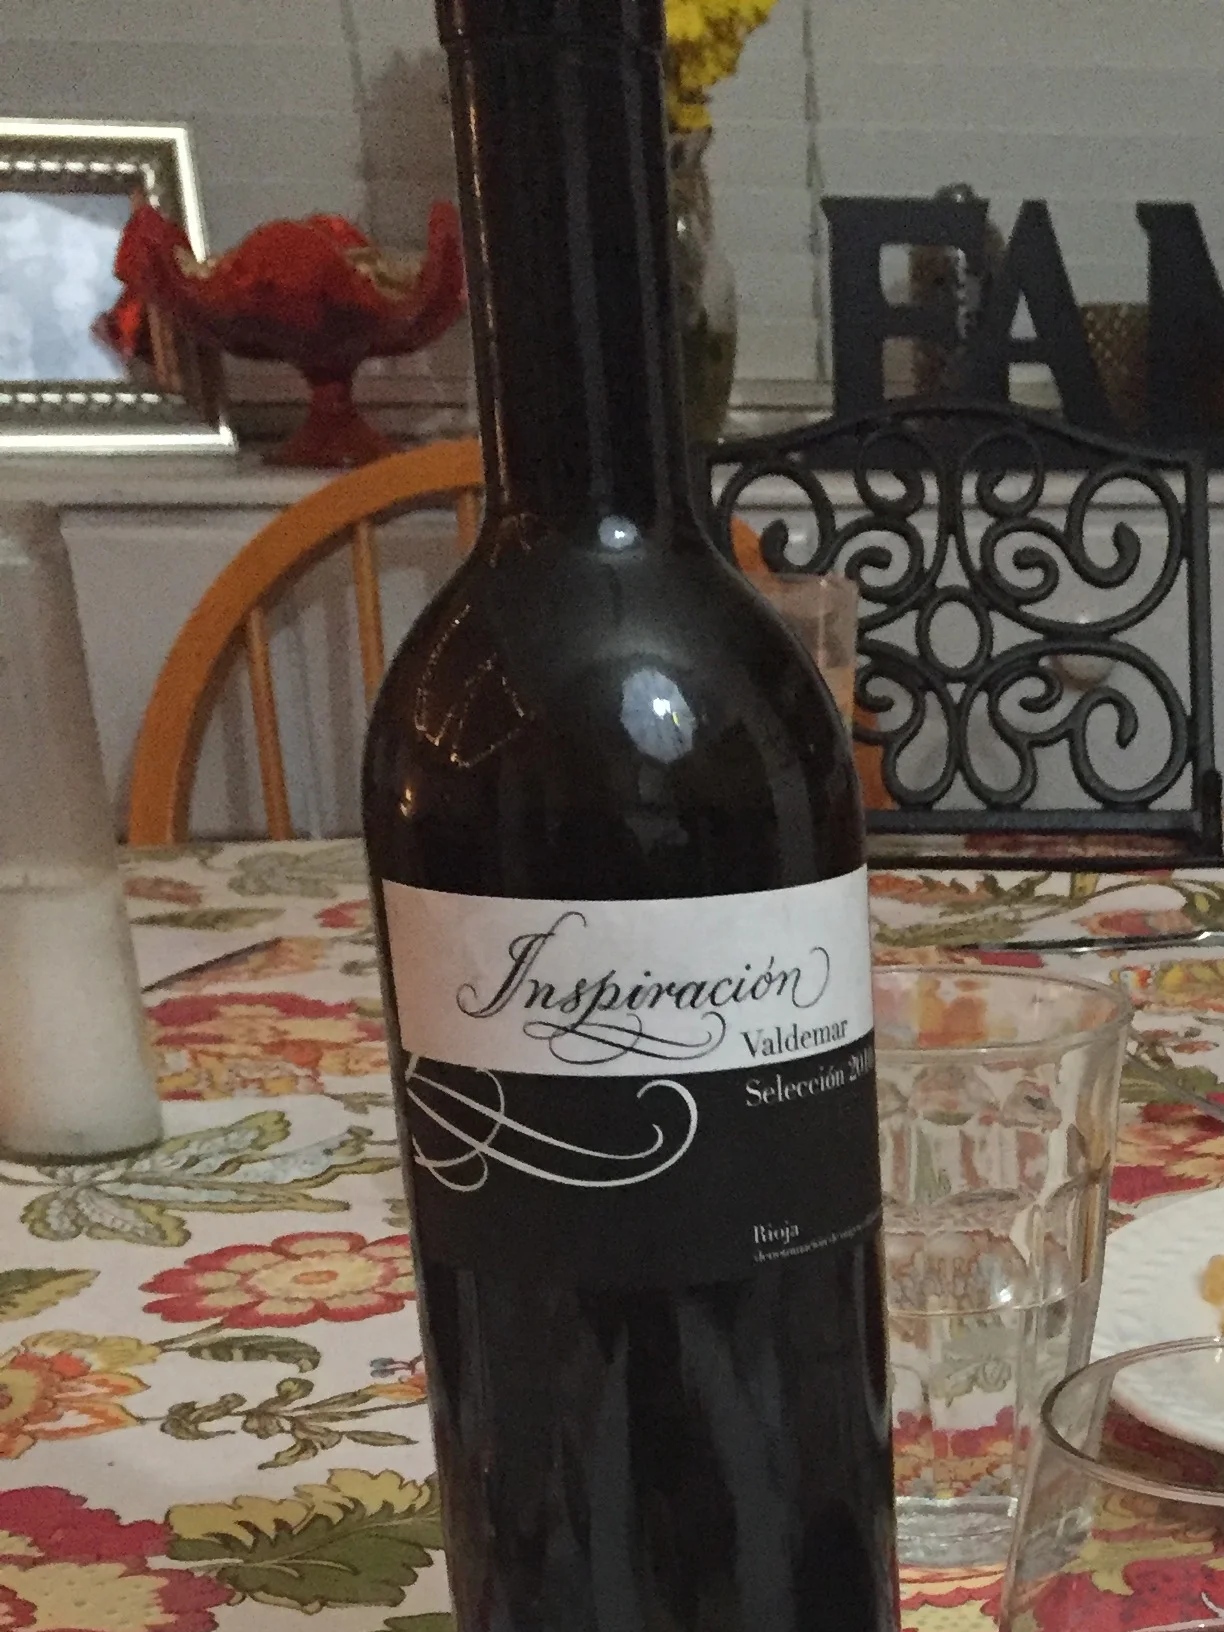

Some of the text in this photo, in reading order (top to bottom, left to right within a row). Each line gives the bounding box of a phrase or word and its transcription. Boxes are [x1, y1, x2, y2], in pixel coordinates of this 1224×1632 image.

[456, 911, 830, 1064] Inspiración
[741, 1018, 849, 1058] Valdemar
[745, 1063, 846, 1107] Selección
[753, 1219, 800, 1245] Rioja
